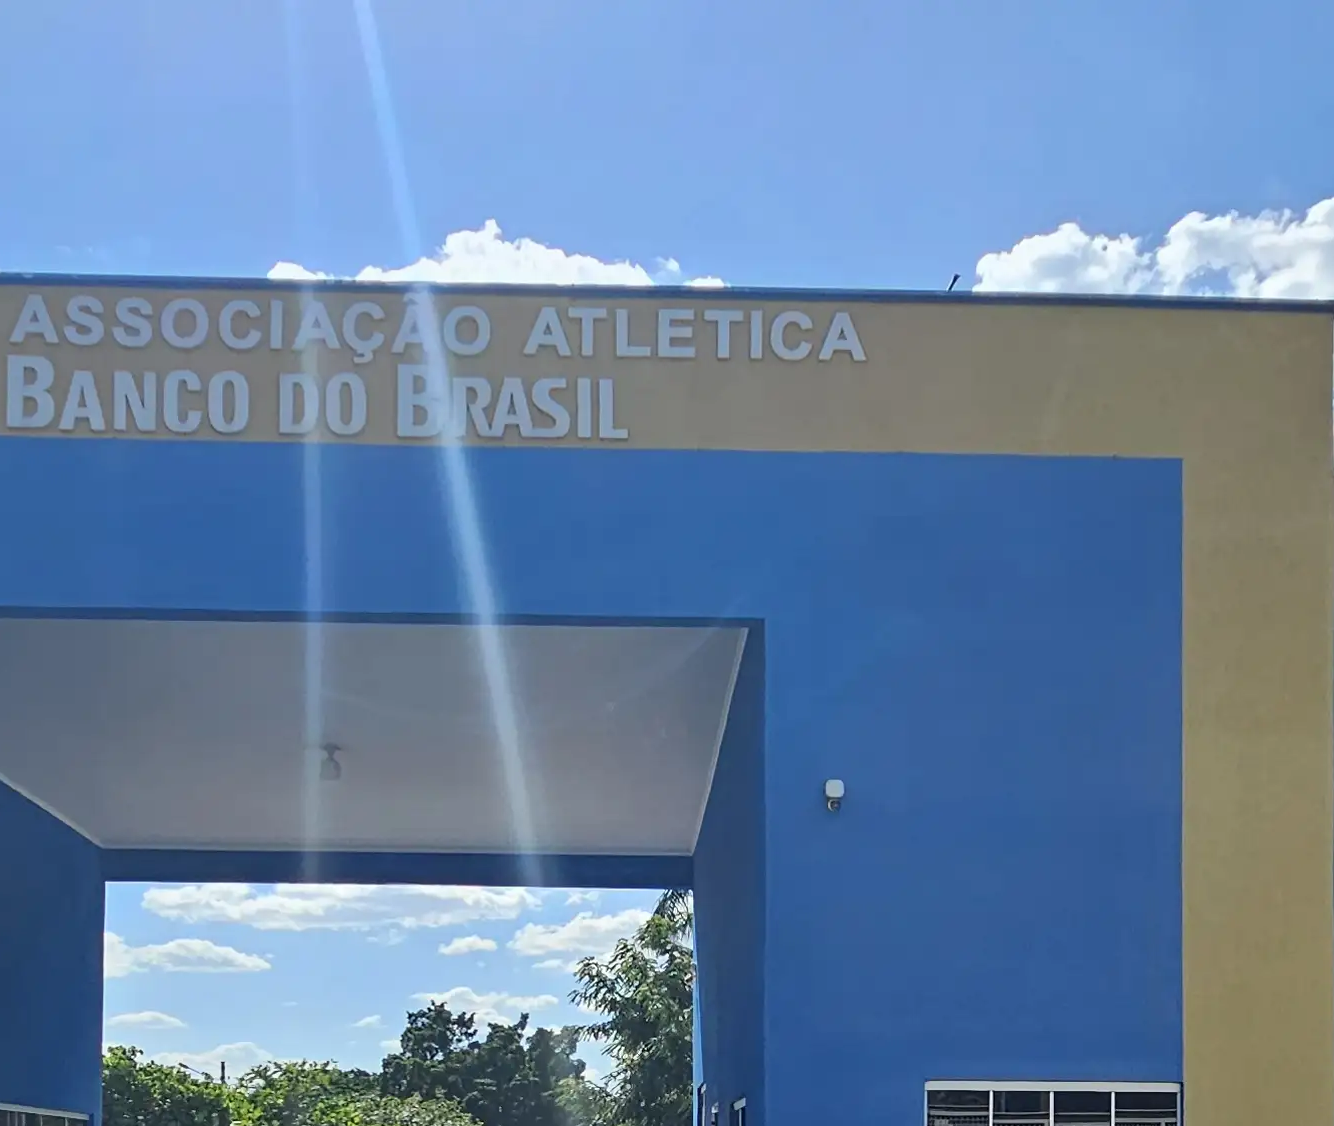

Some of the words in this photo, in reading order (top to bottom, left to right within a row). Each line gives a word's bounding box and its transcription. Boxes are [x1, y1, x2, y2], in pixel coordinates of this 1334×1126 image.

[9, 291, 492, 362] ASSOCIAÇÃO
[5, 354, 249, 436] BANCO
[279, 373, 367, 436] DO
[396, 363, 629, 440] BRASIL
